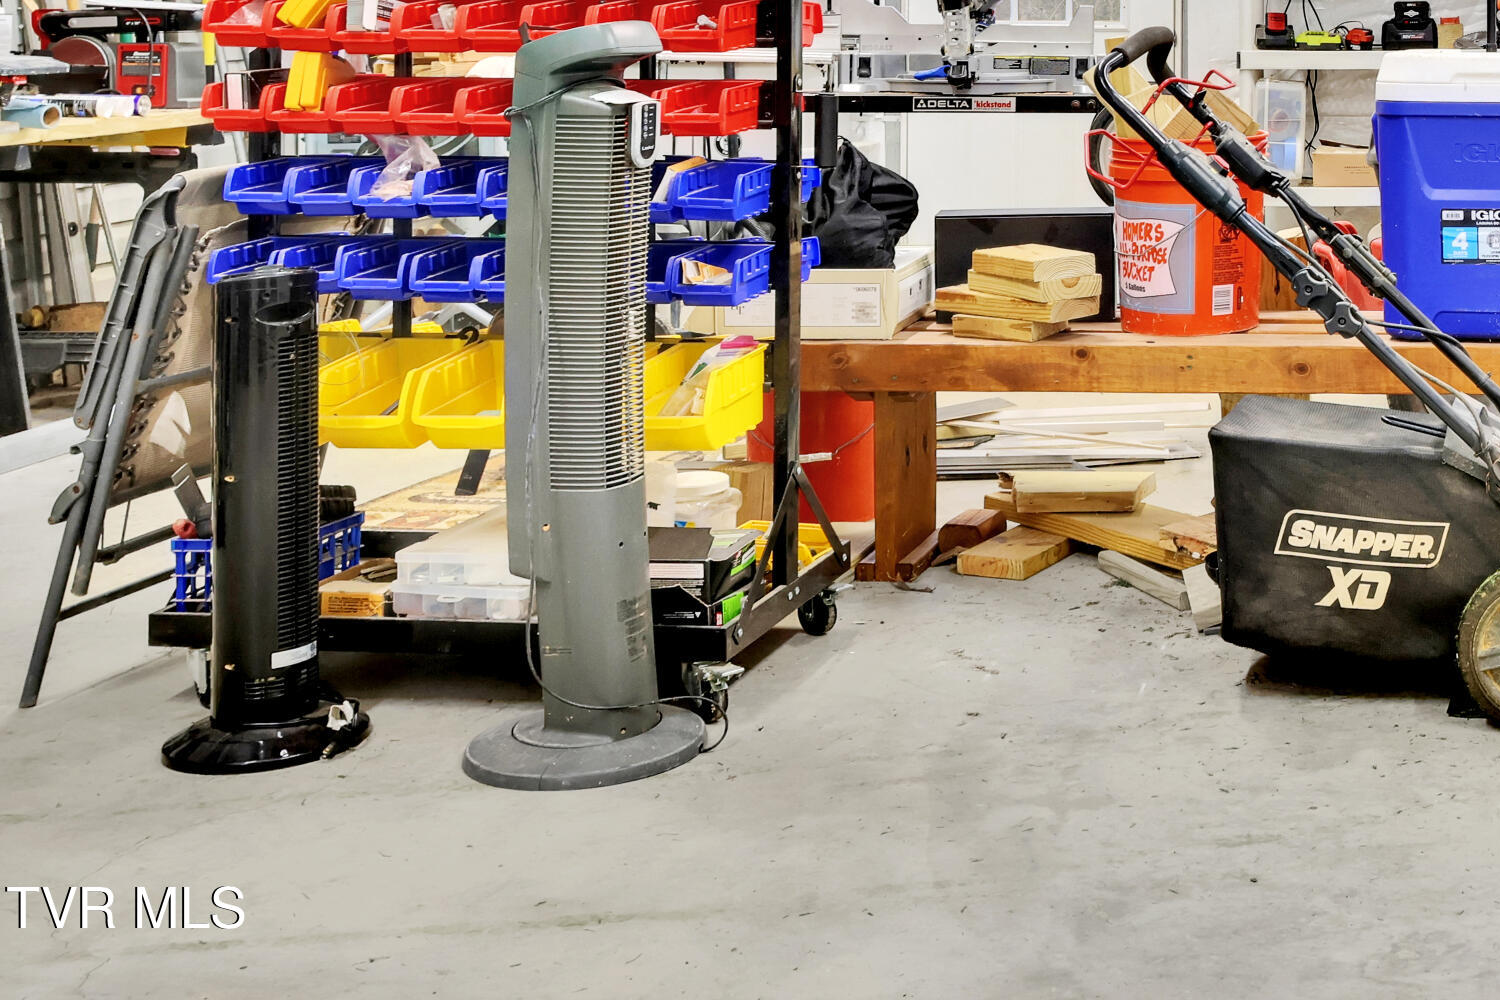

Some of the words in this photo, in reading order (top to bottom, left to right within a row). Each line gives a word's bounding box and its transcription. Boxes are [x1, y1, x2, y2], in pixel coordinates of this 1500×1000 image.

[927, 100, 970, 108] DELTA
[1451, 231, 1469, 251] 4
[1122, 261, 1155, 282] BUCKET
[1288, 519, 1435, 559] SNAPPER
[1314, 565, 1392, 610] XD
